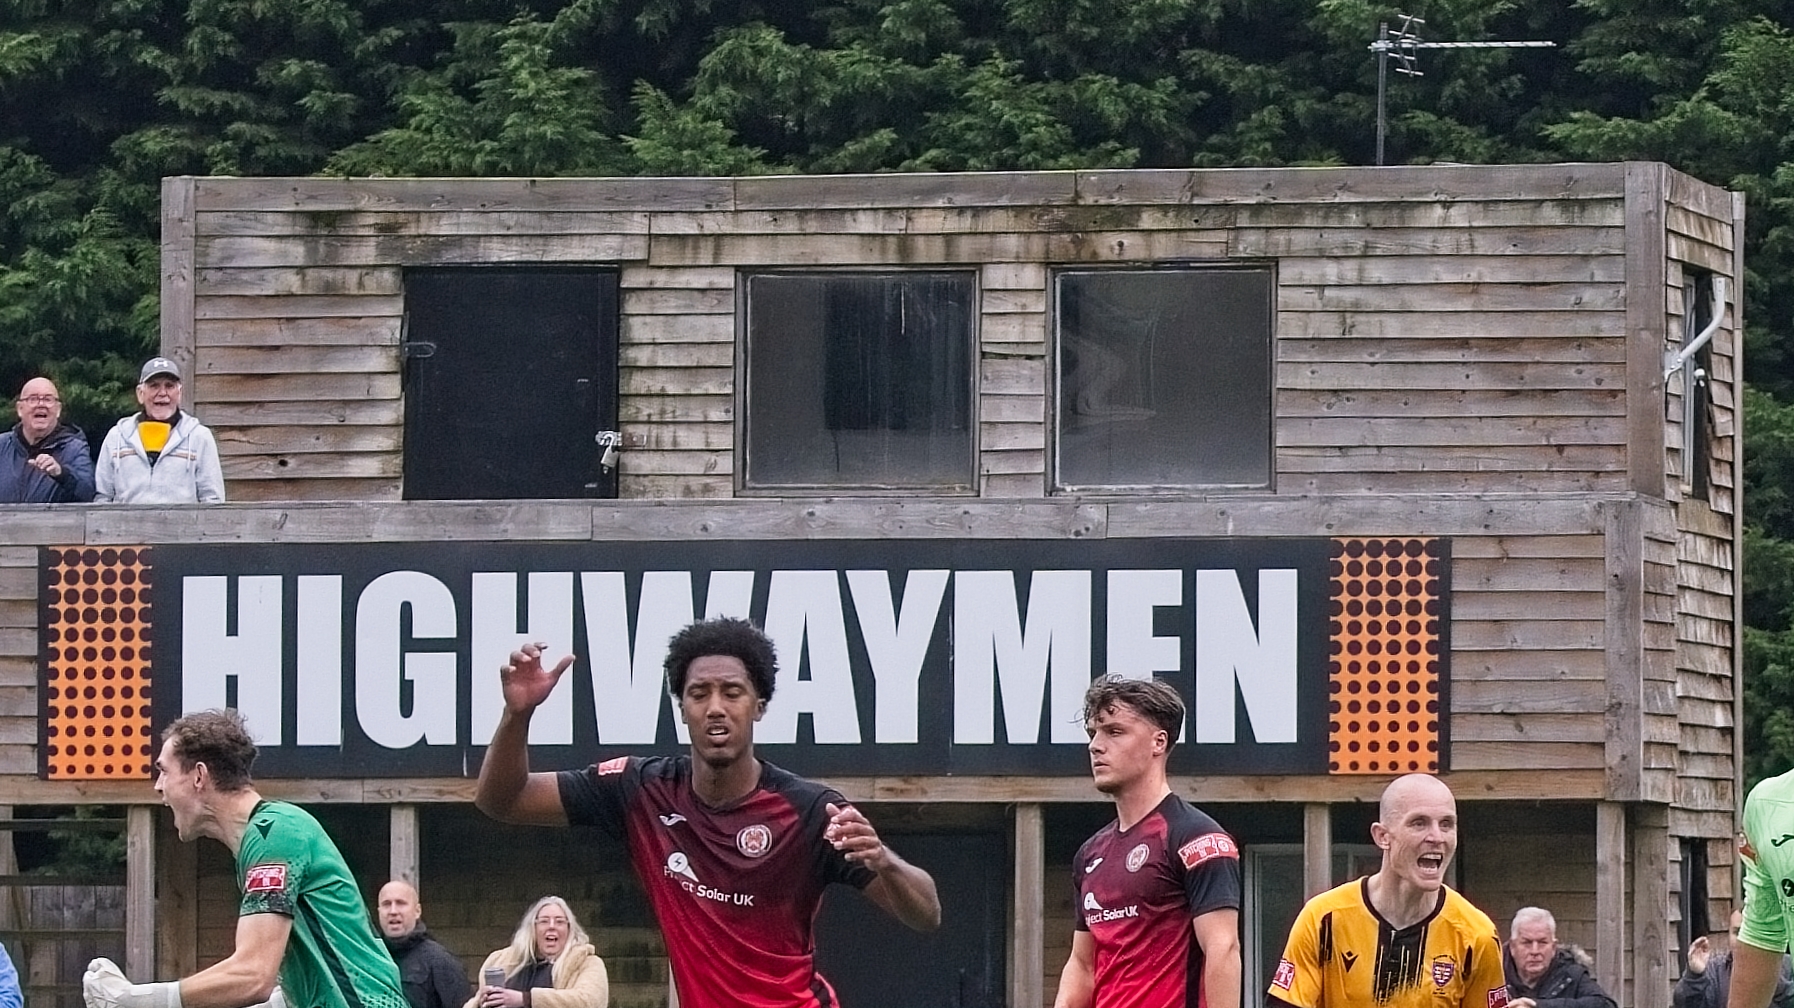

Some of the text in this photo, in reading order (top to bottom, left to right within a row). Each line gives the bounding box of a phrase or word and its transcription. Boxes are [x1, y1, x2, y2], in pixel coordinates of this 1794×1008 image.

[182, 569, 1298, 749] HIGHWAYMEN
[696, 884, 731, 903] Solar
[733, 892, 755, 907] UK
[1103, 908, 1125, 921] Solar
[1124, 905, 1139, 917] UK
